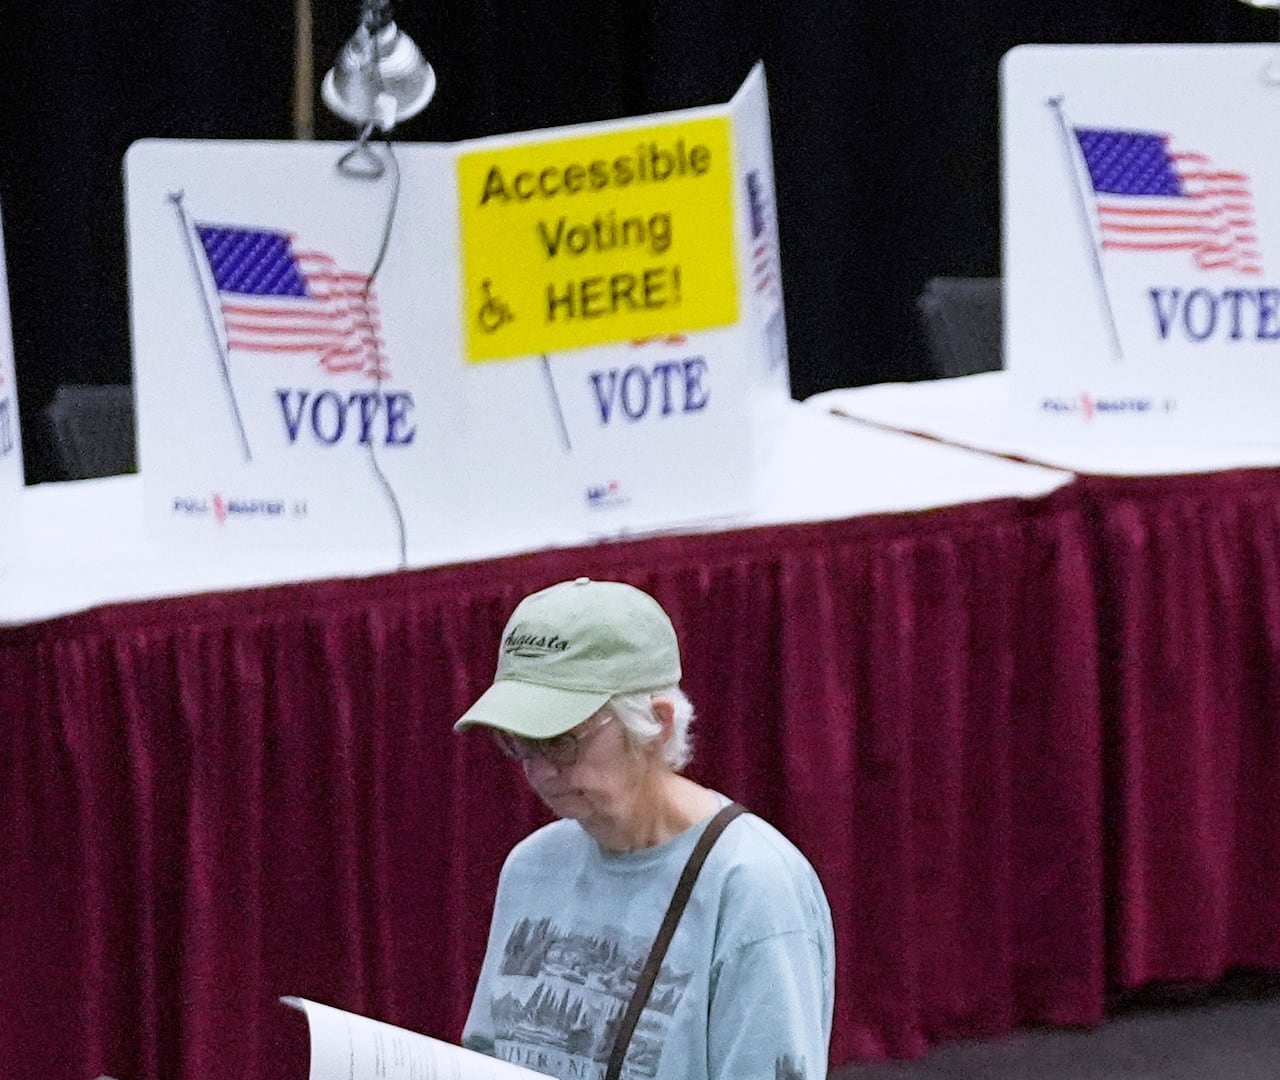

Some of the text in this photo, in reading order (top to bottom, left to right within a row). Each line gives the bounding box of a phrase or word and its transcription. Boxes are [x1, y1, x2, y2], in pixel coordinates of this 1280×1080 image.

[480, 138, 711, 206] Accessible
[537, 208, 672, 257] Voting
[546, 264, 682, 322] HERE!
[275, 387, 416, 447] VOTE
[588, 355, 711, 425] VOTE
